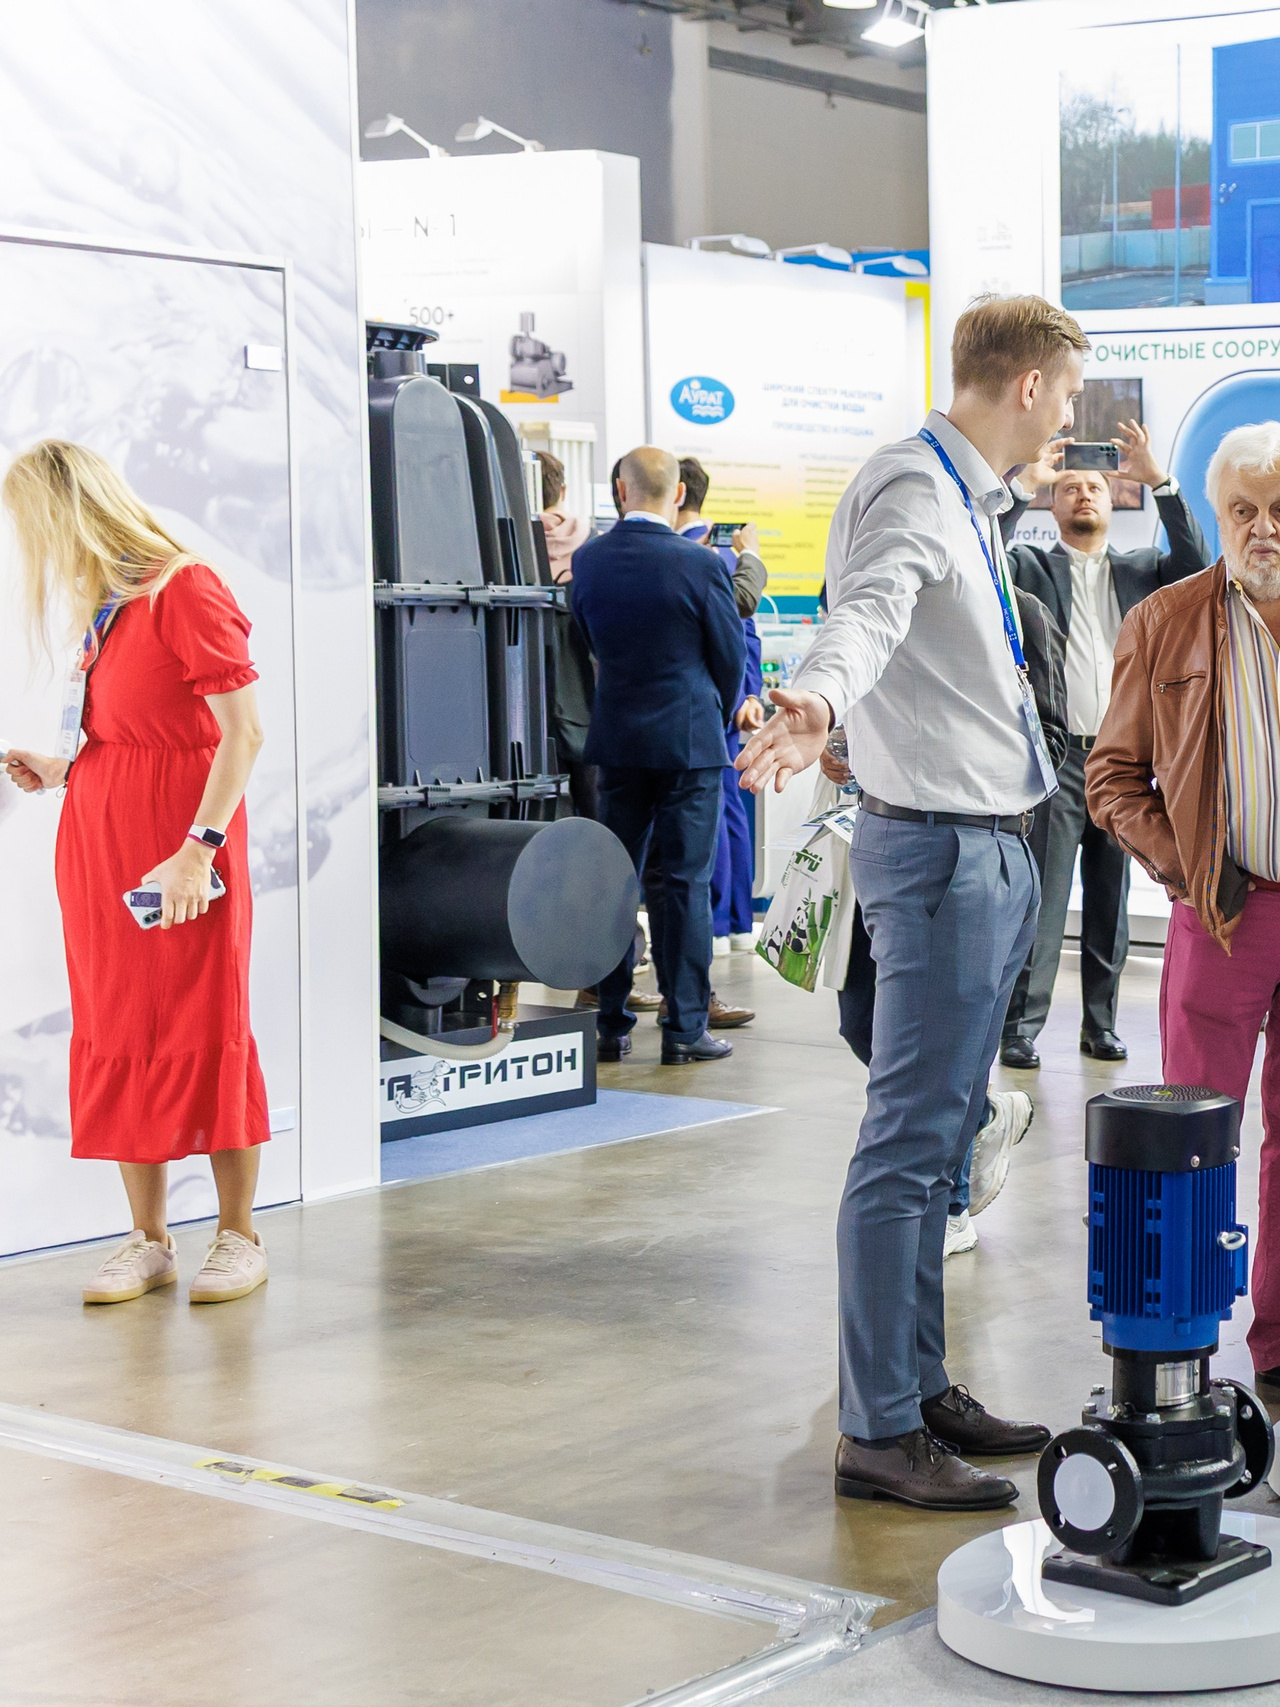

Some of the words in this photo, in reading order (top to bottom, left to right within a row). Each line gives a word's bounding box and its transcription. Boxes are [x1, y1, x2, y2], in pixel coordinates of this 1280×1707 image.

[409, 306, 455, 325] 500+
[1095, 342, 1206, 362] ОЧИСТНЫЕ
[1013, 526, 1057, 540] rof.ru
